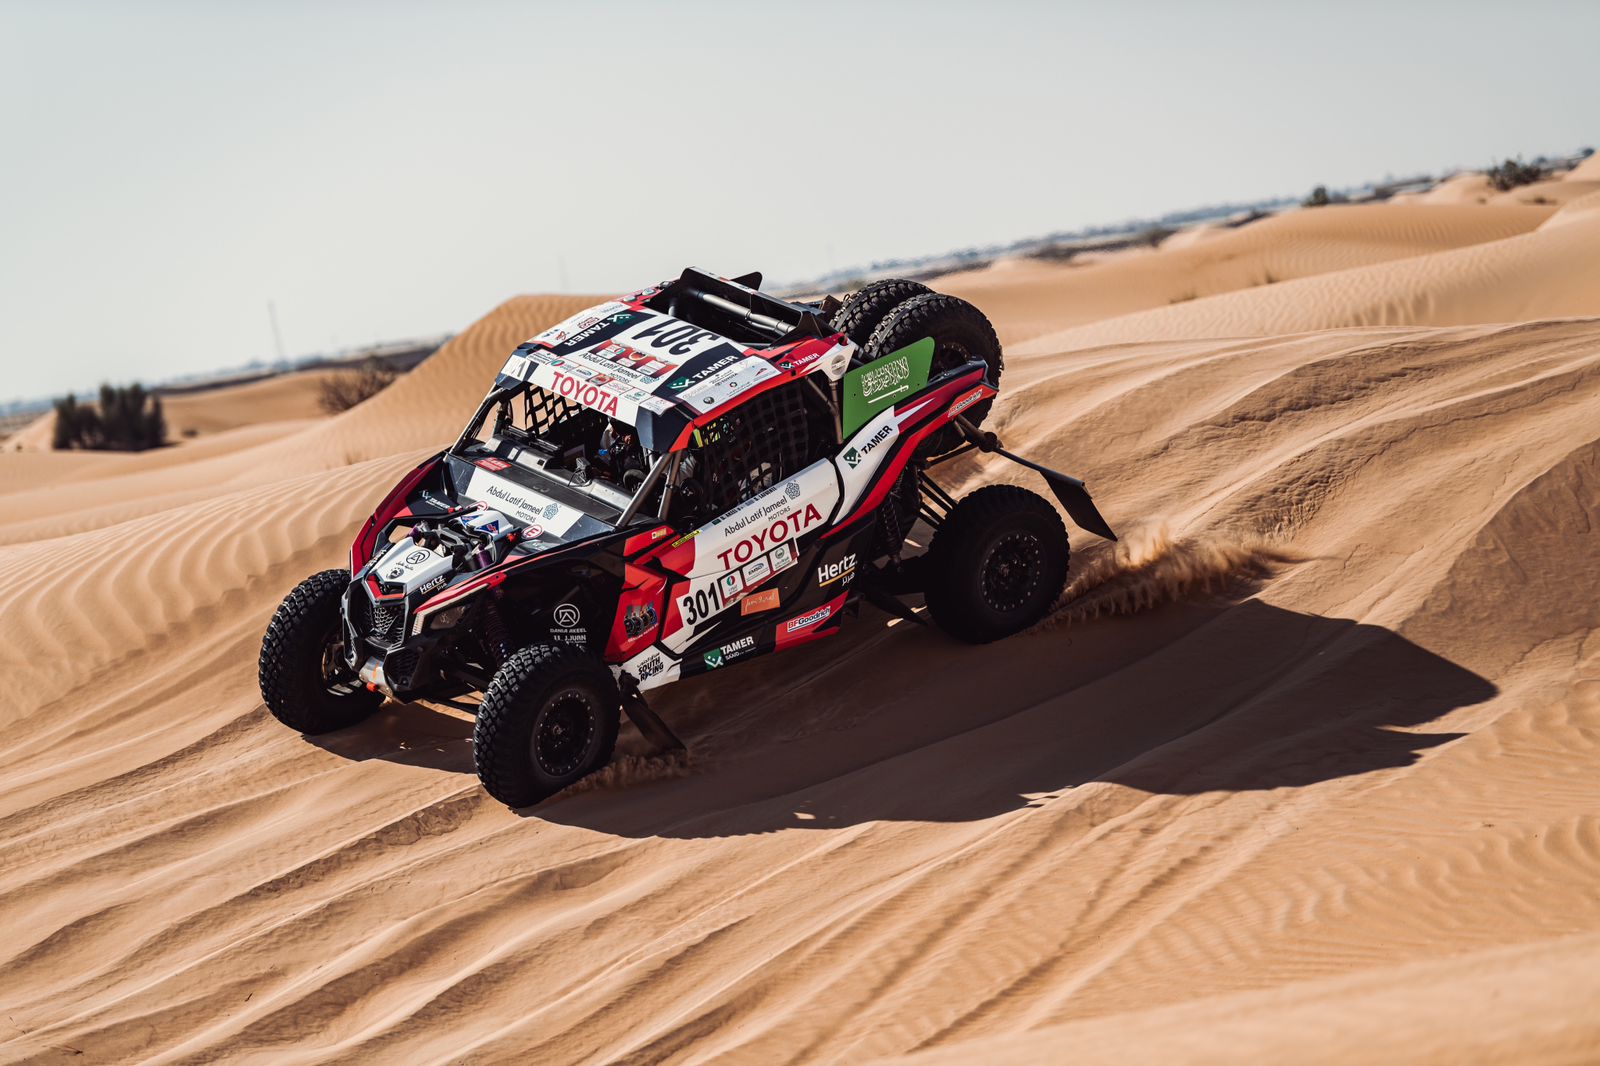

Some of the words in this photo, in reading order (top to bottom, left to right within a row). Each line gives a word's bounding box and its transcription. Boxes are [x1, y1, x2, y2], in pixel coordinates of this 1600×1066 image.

[564, 322, 610, 347] TAMER
[631, 318, 720, 356] 301
[579, 352, 603, 364] Abdul
[613, 367, 640, 380] Jameel
[692, 355, 739, 380] TAMER
[794, 352, 820, 366] TAMER
[609, 373, 631, 384] MOTORS
[550, 371, 618, 417] TOYOTA
[861, 425, 893, 455] TAMER
[486, 485, 506, 499] Abdul
[505, 492, 521, 504] Latif
[520, 499, 543, 515] Jameel
[516, 510, 536, 523] MOTORS
[724, 519, 746, 537] Abdul
[744, 508, 763, 527] Latif
[763, 496, 788, 516] Jameel
[768, 505, 791, 522] MOTORS
[717, 503, 822, 571] TOYOTA
[817, 552, 856, 583] Hertz
[419, 574, 445, 593] Hertz
[683, 582, 721, 626] 301
[788, 605, 831, 629] BFGoodrich
[720, 636, 754, 655] TAMER
[638, 654, 661, 675] SOUTH
